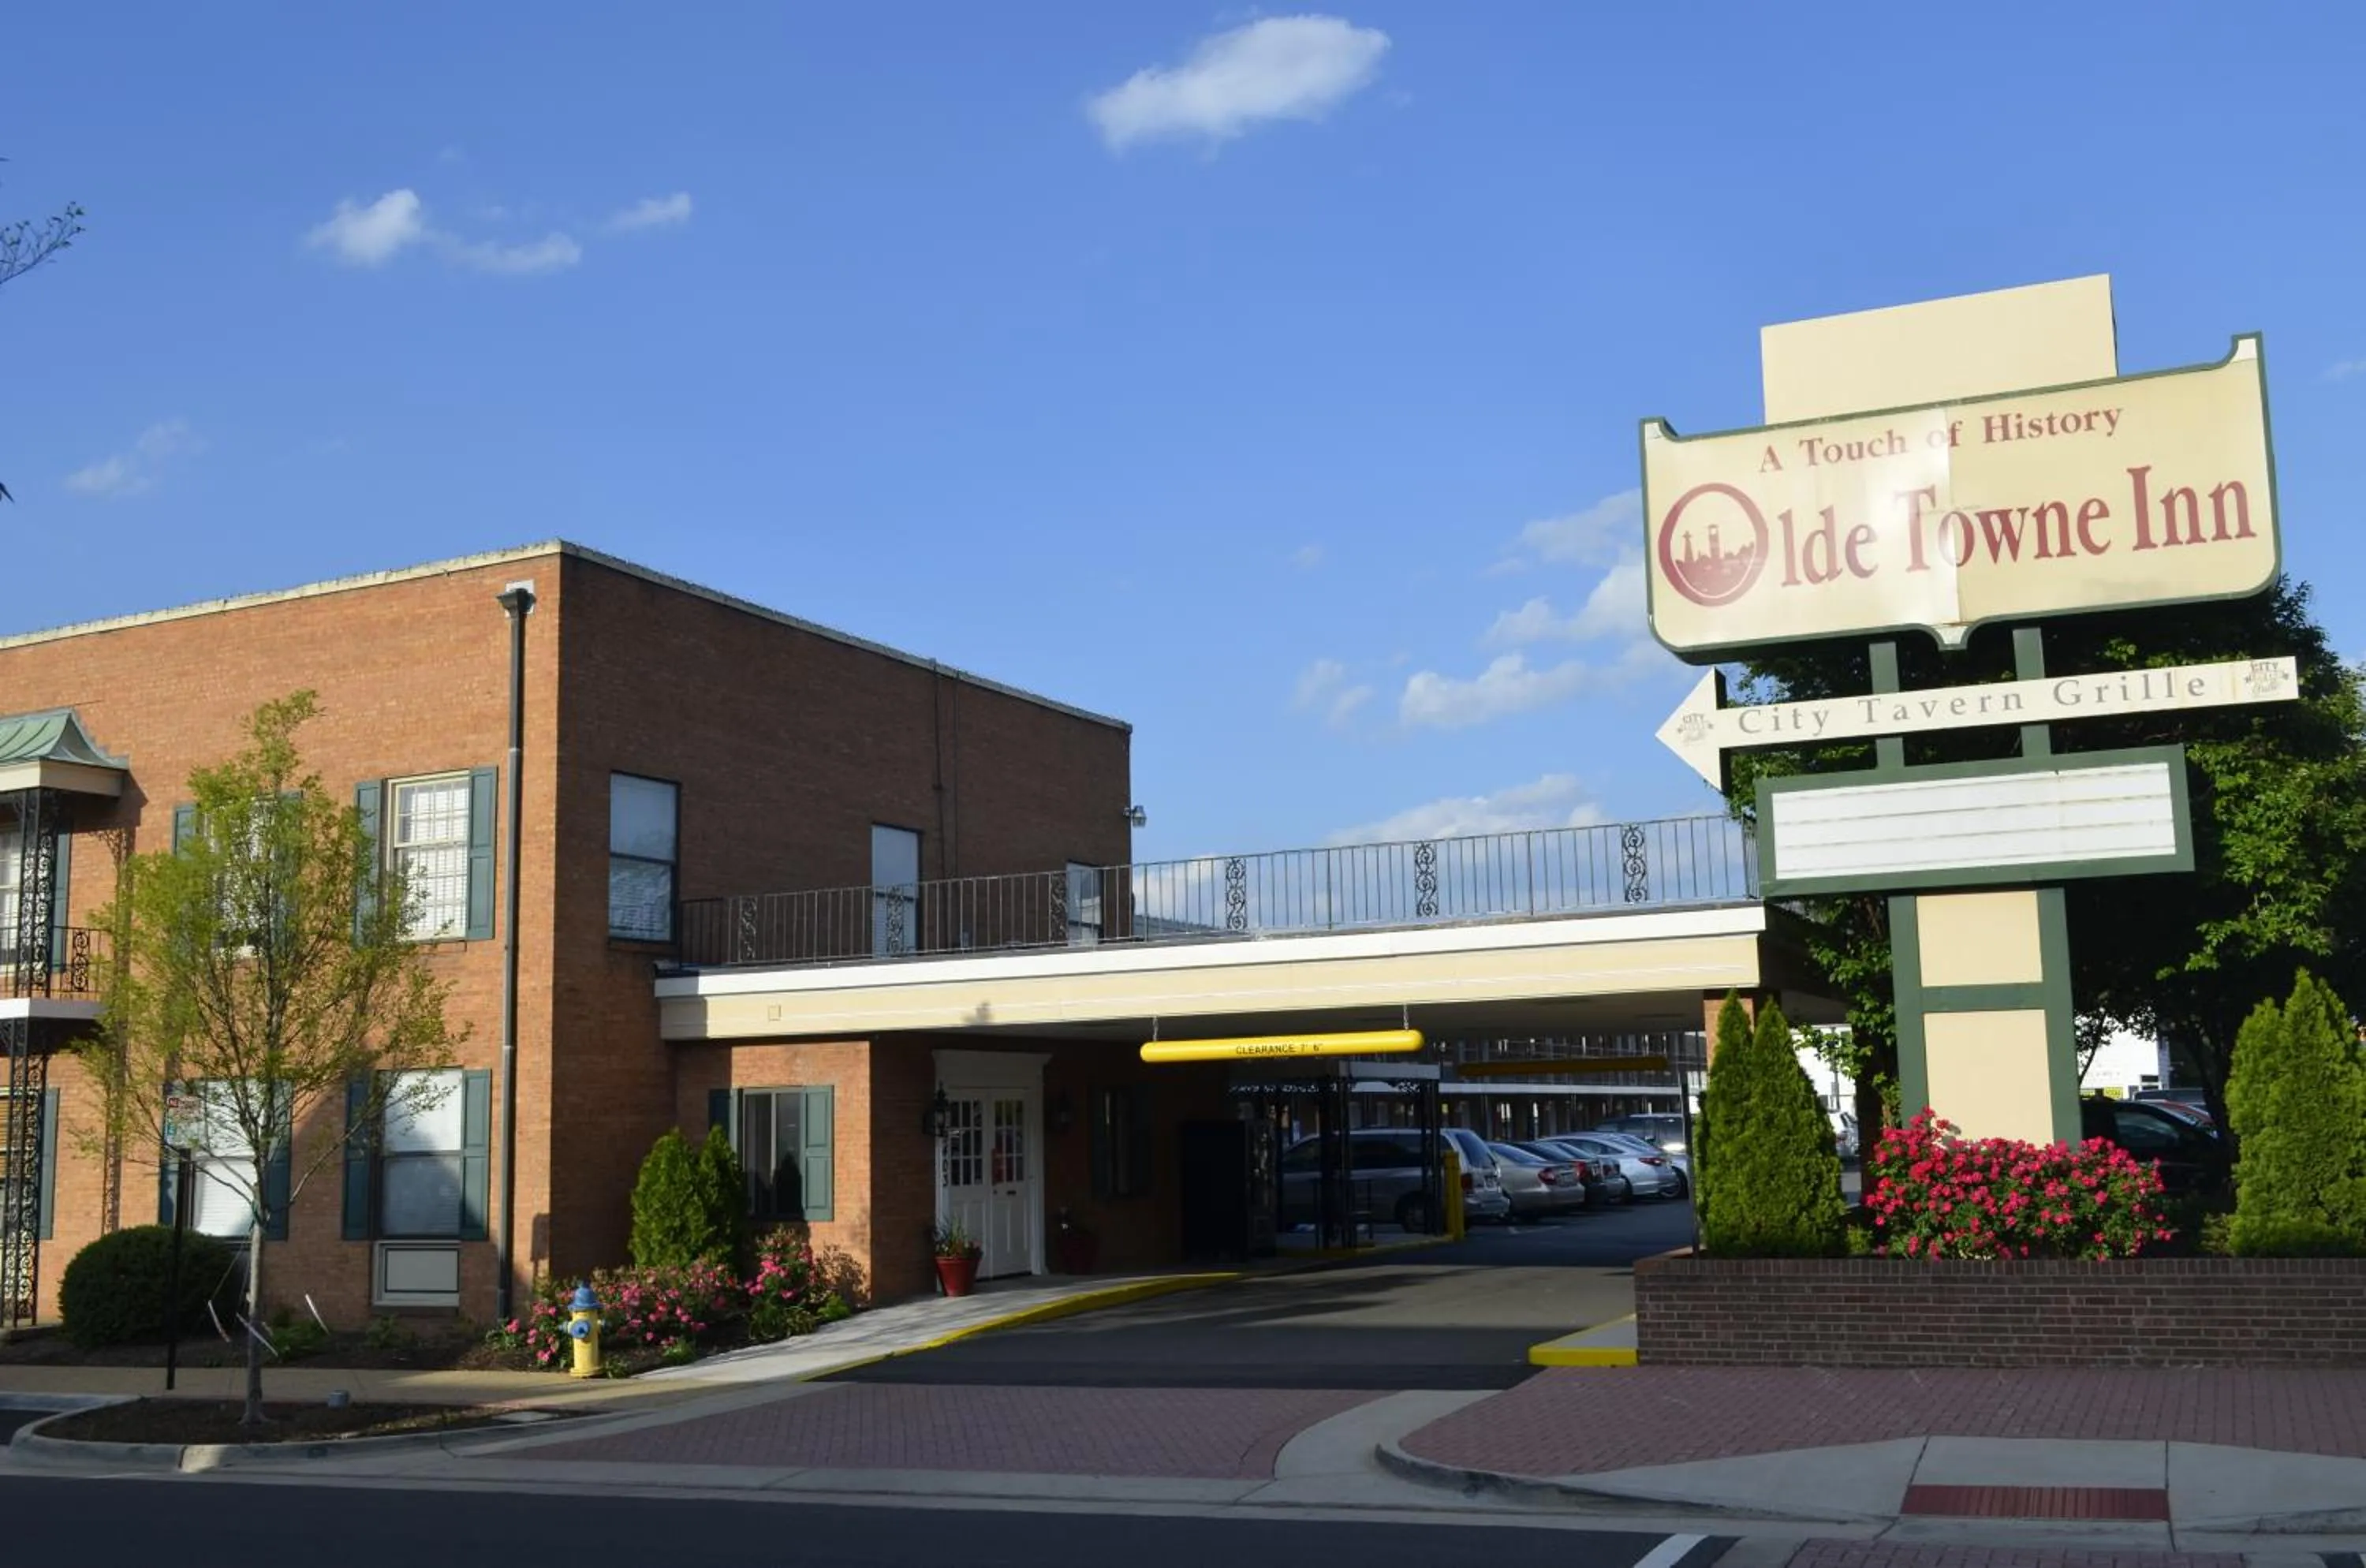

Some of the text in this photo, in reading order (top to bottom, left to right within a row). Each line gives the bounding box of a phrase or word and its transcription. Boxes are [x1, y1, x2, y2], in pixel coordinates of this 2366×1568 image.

[1759, 407, 2124, 473] A Touch of History
[1659, 465, 2256, 607] Olde Towne Inn
[1737, 672, 2206, 736] City Tavern Grille
[1235, 1043, 1296, 1055] CLEARANCE
